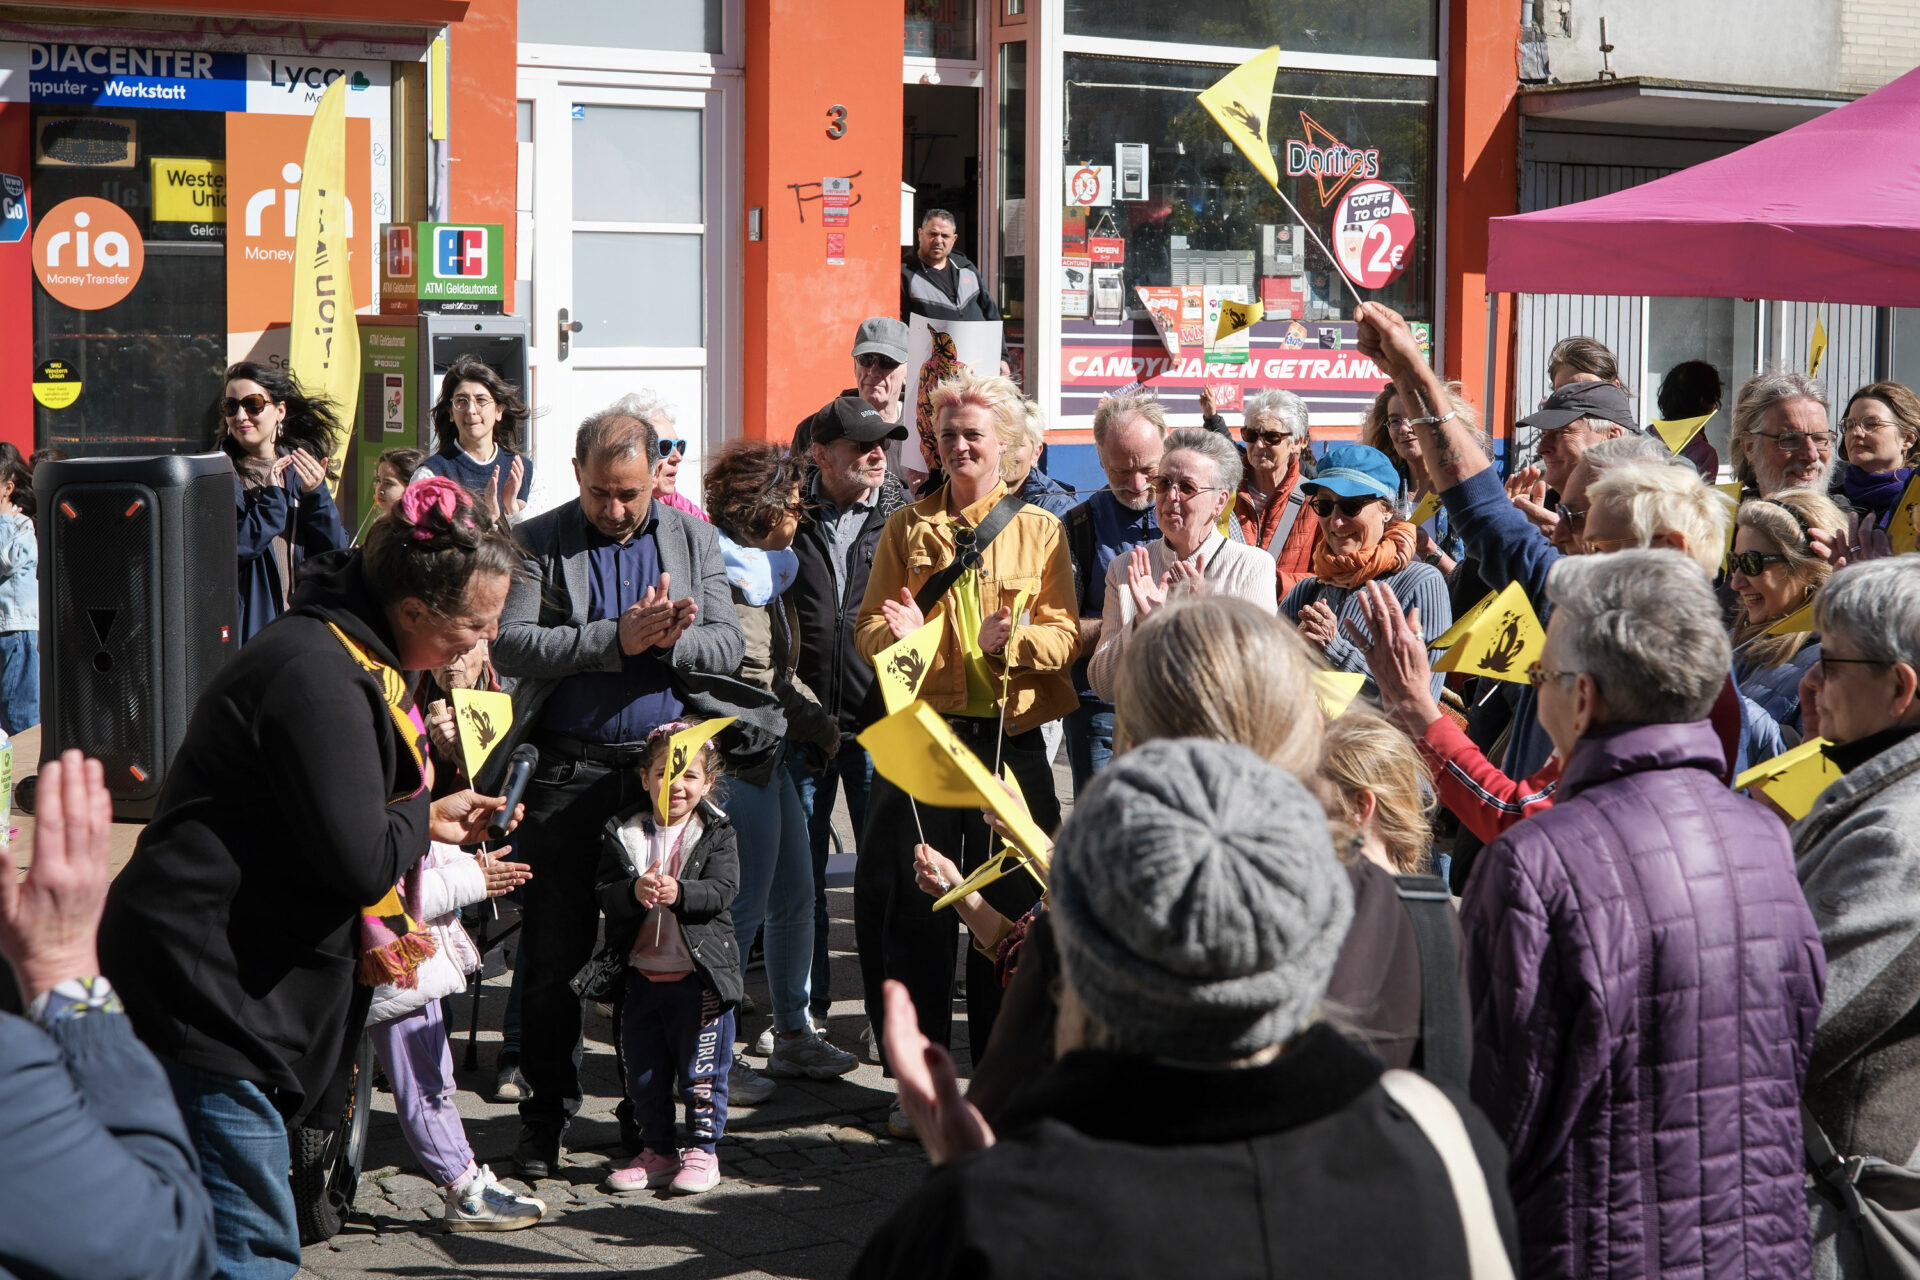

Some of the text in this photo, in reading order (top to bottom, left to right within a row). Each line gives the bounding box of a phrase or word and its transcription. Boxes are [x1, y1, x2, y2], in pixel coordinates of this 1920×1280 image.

[29, 44, 214, 79] DIACENTER
[104, 81, 186, 100] Werkstatt
[827, 103, 848, 138] 3
[1287, 140, 1379, 179] Doritos
[245, 162, 353, 238] ri
[1351, 191, 1391, 207] COFFE
[1354, 207, 1390, 221] TO GO
[47, 211, 129, 268] ria
[1094, 246, 1120, 255] OPEN
[1062, 260, 1089, 268] ACHTUNG
[47, 273, 129, 287] Money Transfer
[425, 282, 498, 295] ATM Geldautomat
[1068, 355, 1258, 379] CANDYWAREN
[694, 1031, 718, 1075] GIRLS
